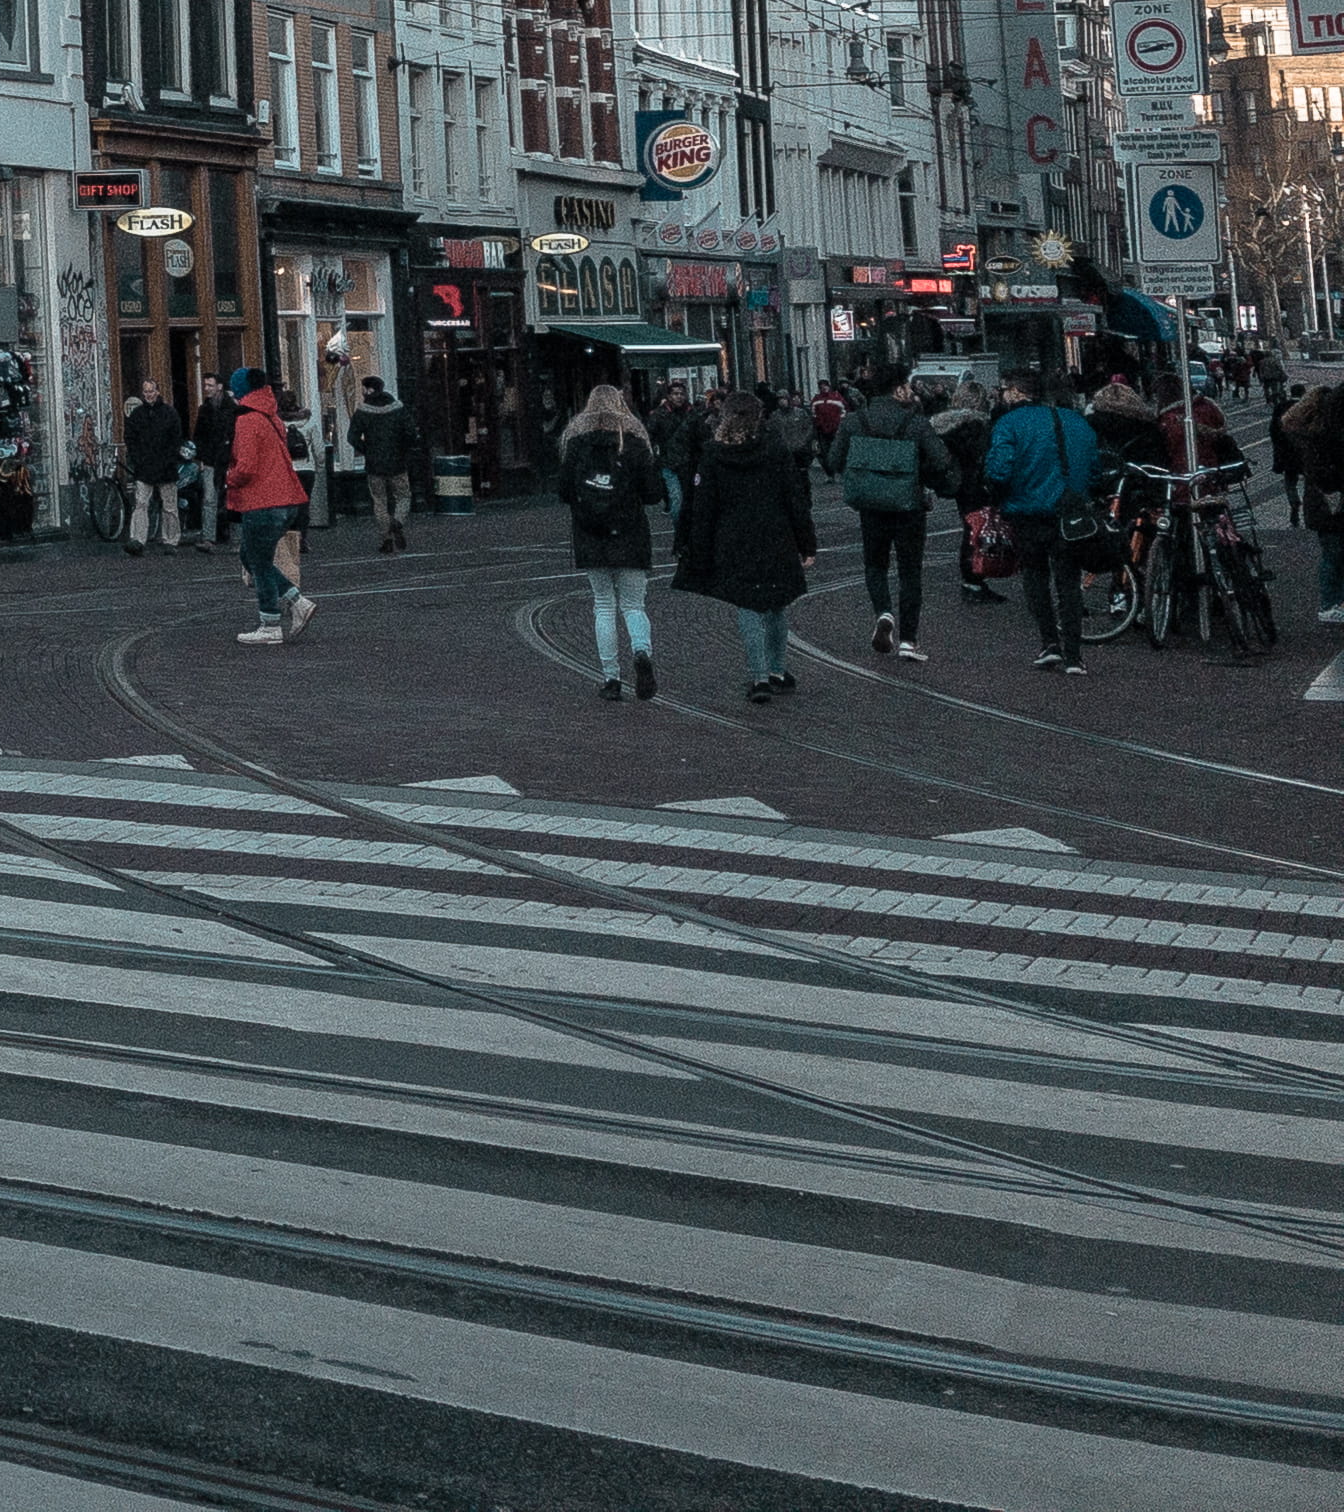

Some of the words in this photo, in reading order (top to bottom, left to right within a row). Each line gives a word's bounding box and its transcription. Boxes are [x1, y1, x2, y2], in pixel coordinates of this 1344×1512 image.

[1134, 4, 1172, 15] ZONE
[1123, 75, 1195, 85] alcoholverbod
[1140, 112, 1184, 121] Terrassen
[655, 134, 709, 156] BURGER
[658, 146, 712, 172] KING
[1159, 169, 1193, 180] ZONE
[79, 185, 104, 196] GIFT
[107, 184, 138, 196] SHOP
[127, 214, 183, 231] FLASH
[539, 238, 582, 250] FLASH
[483, 240, 506, 268] BAR
